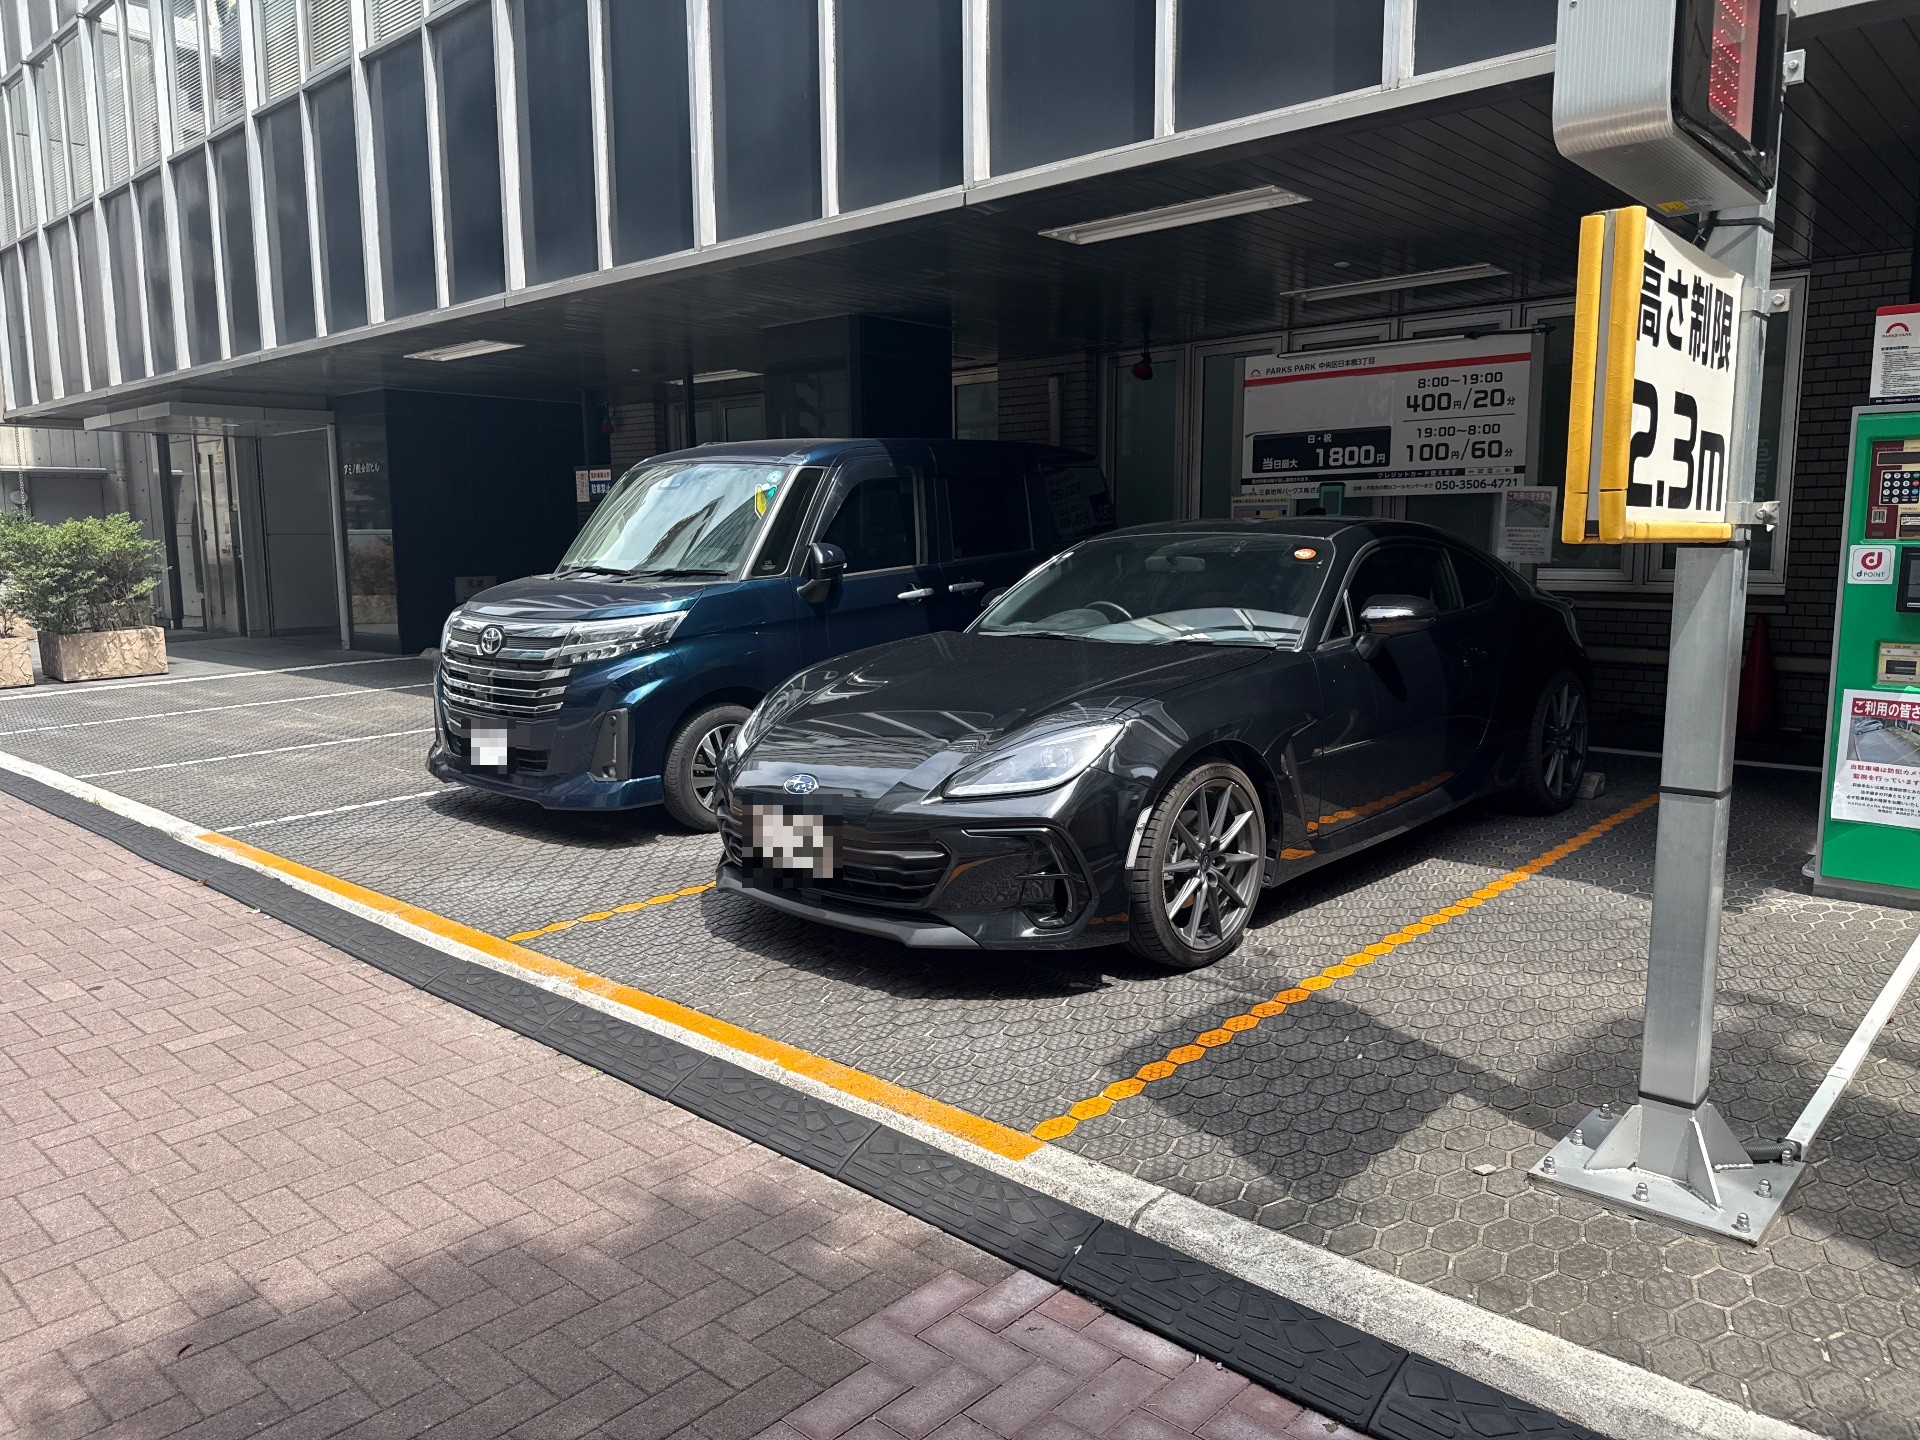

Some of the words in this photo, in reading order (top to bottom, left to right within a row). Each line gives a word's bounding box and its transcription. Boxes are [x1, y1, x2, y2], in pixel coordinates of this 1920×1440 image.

[1635, 250, 1734, 373] 高さ制限
[1265, 365, 1292, 376] PARKS
[1294, 363, 1316, 372] PARK
[1307, 433, 1332, 444] 日・祝
[1626, 378, 1726, 513] 2.3m
[1262, 457, 1299, 470] 当日最大
[1315, 445, 1386, 467] 1800円
[1435, 477, 1518, 491] 050-3506-4721
[1853, 700, 1920, 719] ご利用の皆さ
[1850, 764, 1920, 777] 当駐車場は防犯カメ
